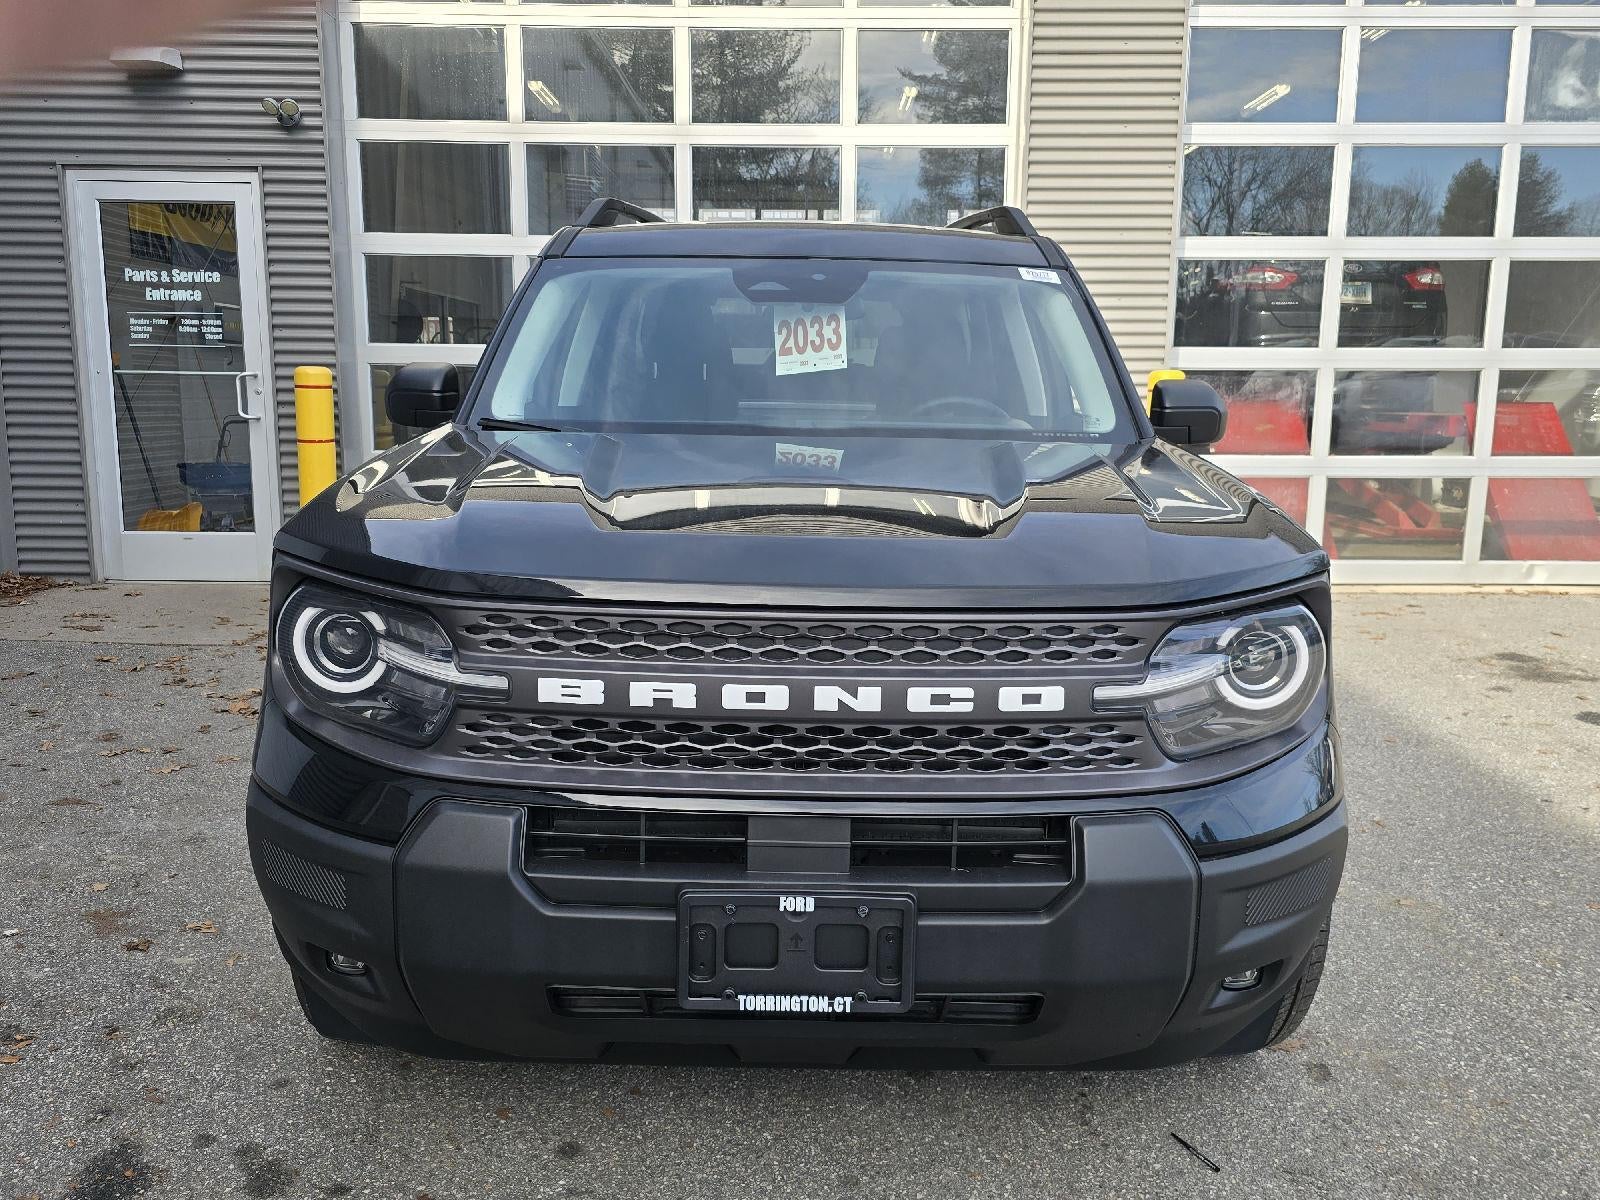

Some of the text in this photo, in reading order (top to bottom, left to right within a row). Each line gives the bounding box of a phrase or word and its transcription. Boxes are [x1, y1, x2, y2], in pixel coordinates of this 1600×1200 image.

[124, 268, 221, 283] Parts & Service
[145, 287, 202, 301] Entrance
[777, 313, 842, 357] 2033
[538, 678, 1065, 713] BRONCO
[779, 896, 815, 912] FORD
